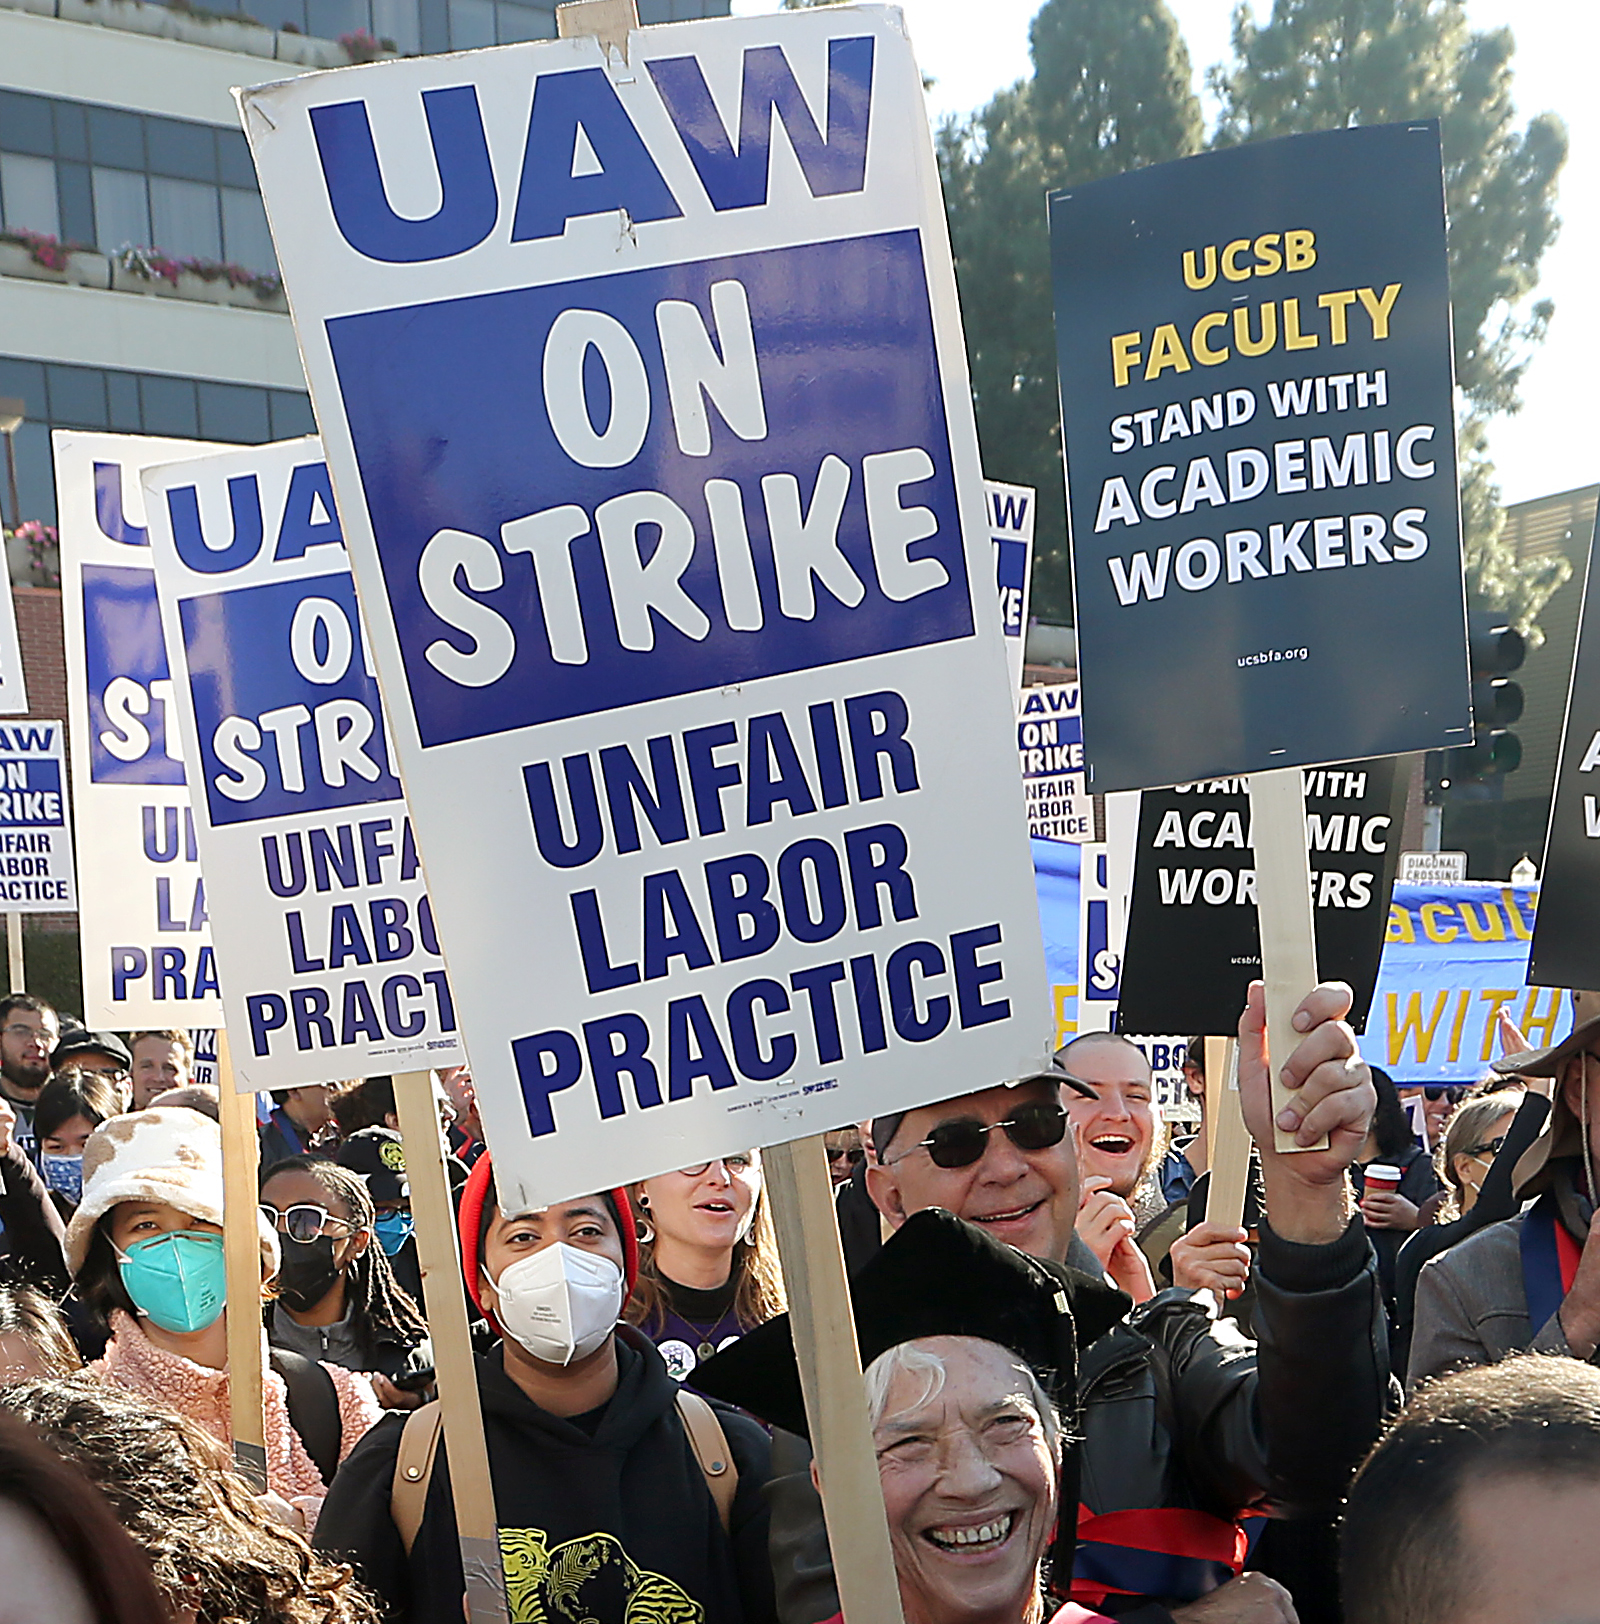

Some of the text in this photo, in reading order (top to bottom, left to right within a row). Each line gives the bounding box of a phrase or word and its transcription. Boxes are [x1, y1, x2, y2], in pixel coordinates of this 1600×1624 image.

[307, 35, 875, 266] UAW
[1181, 228, 1318, 291] UCSB
[541, 278, 768, 469] ON
[1110, 283, 1403, 389] FACULTY
[1109, 369, 1389, 455] STAND WITH
[1093, 424, 1436, 533] ACADEMIC
[418, 447, 950, 689] STRIKE
[1106, 508, 1430, 607] WORKERS
[1236, 644, 1310, 669] ucsbfa.org
[521, 690, 921, 870] UNFAIR
[1022, 721, 1059, 749] ON
[569, 822, 920, 995] LABOR
[1406, 869, 1461, 881] CROSSING
[1408, 857, 1459, 870] DIAGONAL
[510, 923, 1012, 1140] PRACTICE
[1385, 987, 1563, 1067] WITH
